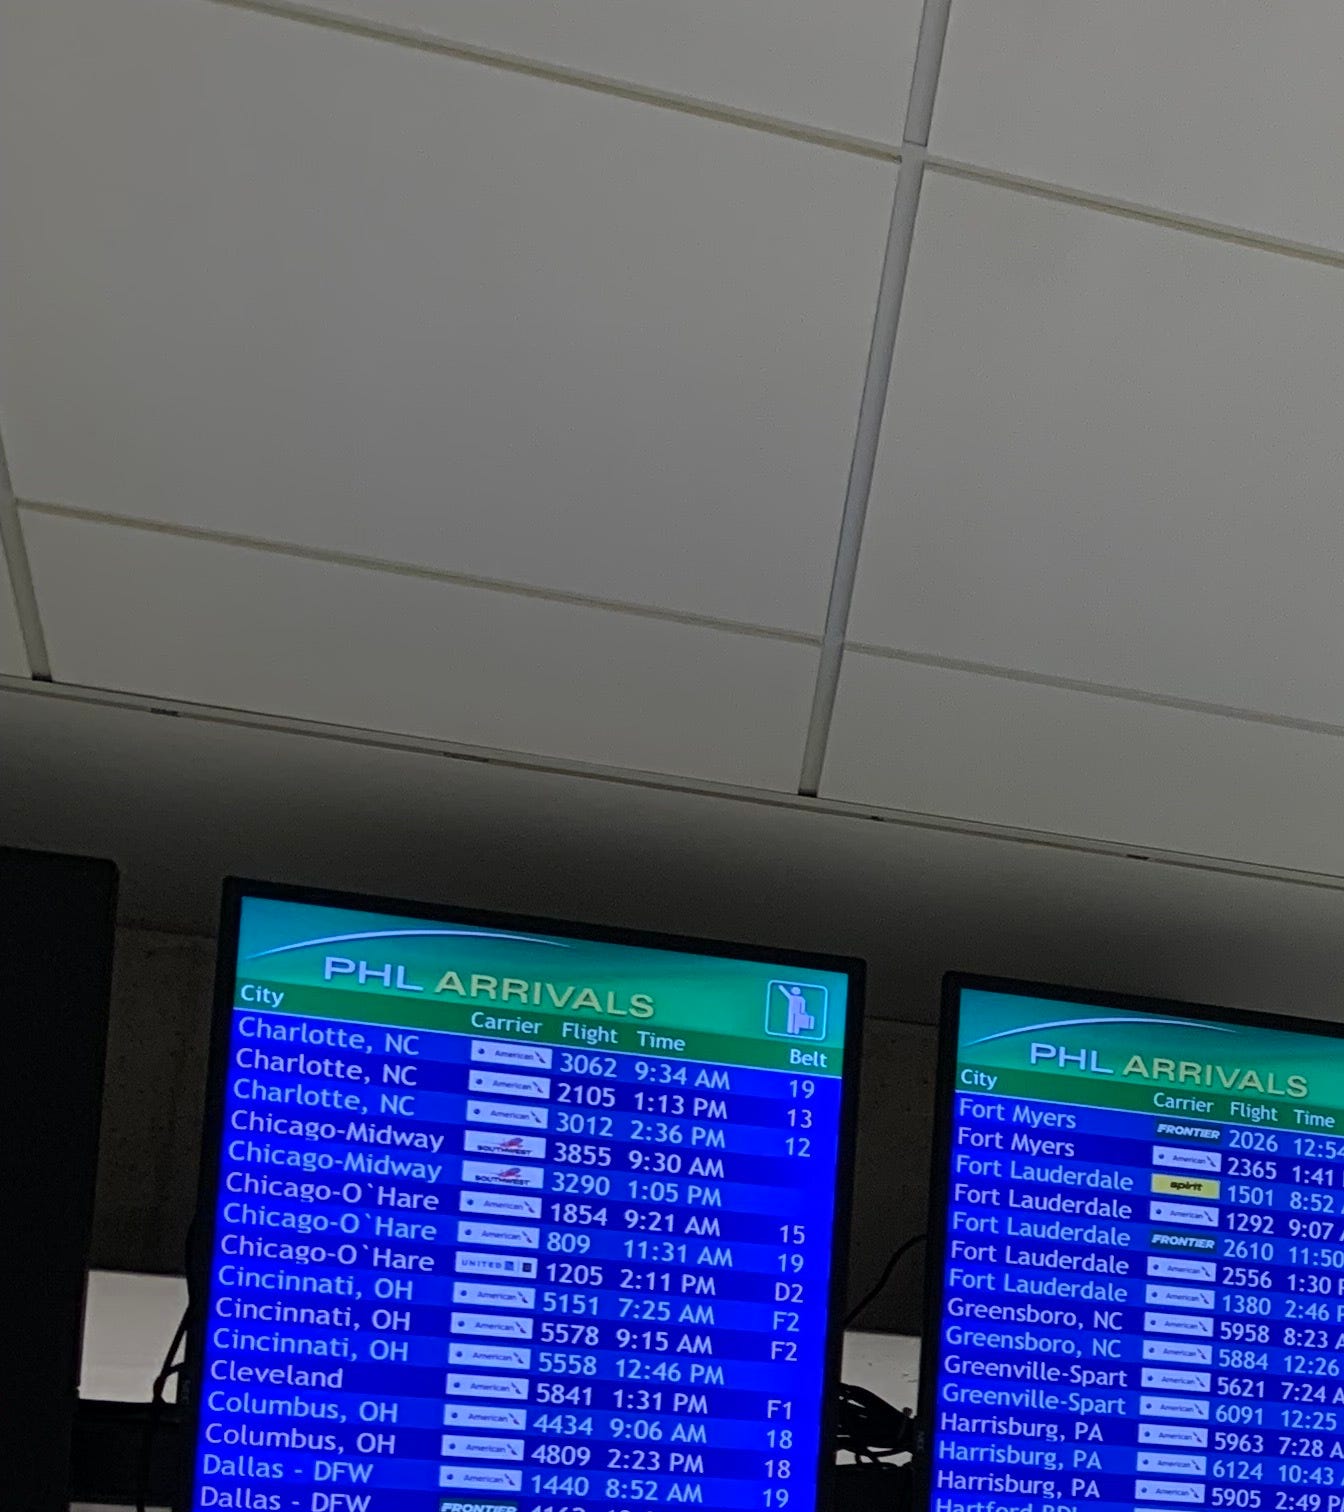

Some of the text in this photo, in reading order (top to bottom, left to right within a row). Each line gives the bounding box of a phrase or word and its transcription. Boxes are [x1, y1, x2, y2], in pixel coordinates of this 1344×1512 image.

[325, 957, 653, 1017] PHL ARRIVALS
[241, 985, 827, 1067] City Carrier Flight Time Belt
[239, 1016, 372, 1054] Charlotte,
[385, 1033, 419, 1055] NC
[560, 1053, 617, 1077] 3062
[635, 1061, 687, 1085] 9:34
[694, 1069, 730, 1090] AM
[790, 1080, 815, 1099] 19
[1031, 1043, 1307, 1097] PHL ARRIVALS
[231, 1110, 444, 1153] Chicago-Midway
[554, 1142, 611, 1166] 3855
[629, 1150, 681, 1173] 9:30
[689, 1157, 724, 1178] AM
[957, 1154, 1001, 1177] Fort
[1010, 1161, 1133, 1191] Lauderdale
[1169, 1181, 1204, 1192] spirit
[1228, 1185, 1273, 1206] 1501
[1290, 1191, 1334, 1213] 8:52
[461, 1259, 502, 1269] UNITED
[547, 1263, 603, 1286] 1205
[620, 1269, 670, 1291] 2:11
[681, 1274, 715, 1295] PM
[775, 1282, 803, 1303] D2
